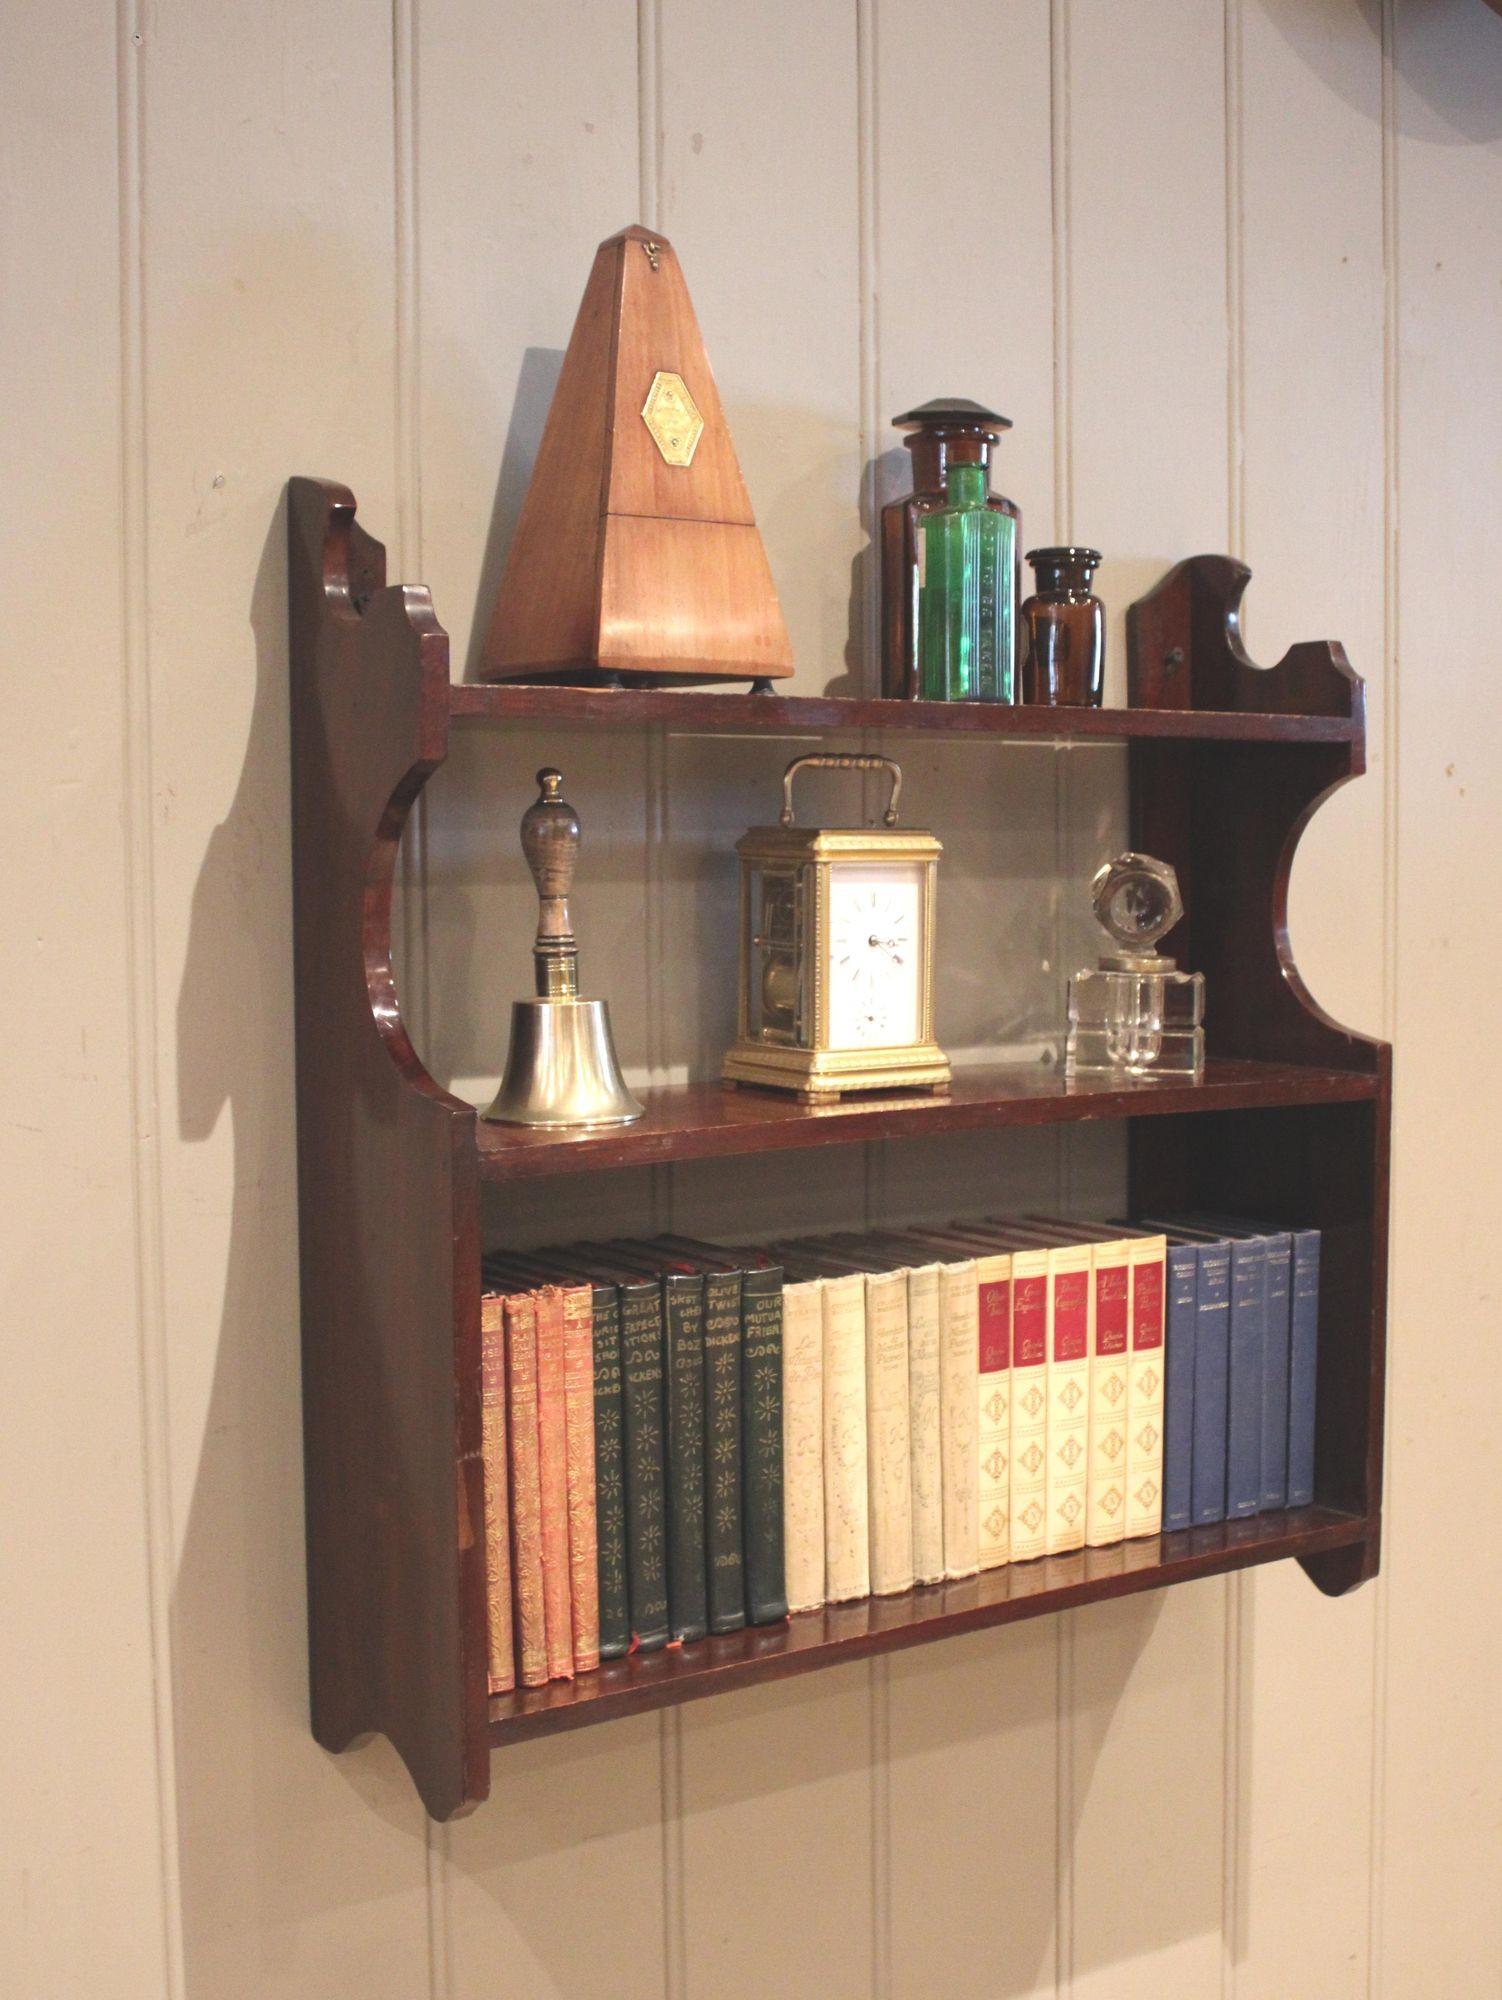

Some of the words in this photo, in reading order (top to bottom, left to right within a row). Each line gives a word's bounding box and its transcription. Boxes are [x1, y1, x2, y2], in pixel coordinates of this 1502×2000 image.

[981, 595, 993, 618] BE
[623, 1299, 660, 1315] GREAT
[756, 1296, 782, 1311] OUR
[682, 1321, 698, 1333] BY
[677, 1339, 702, 1352] BOZ
